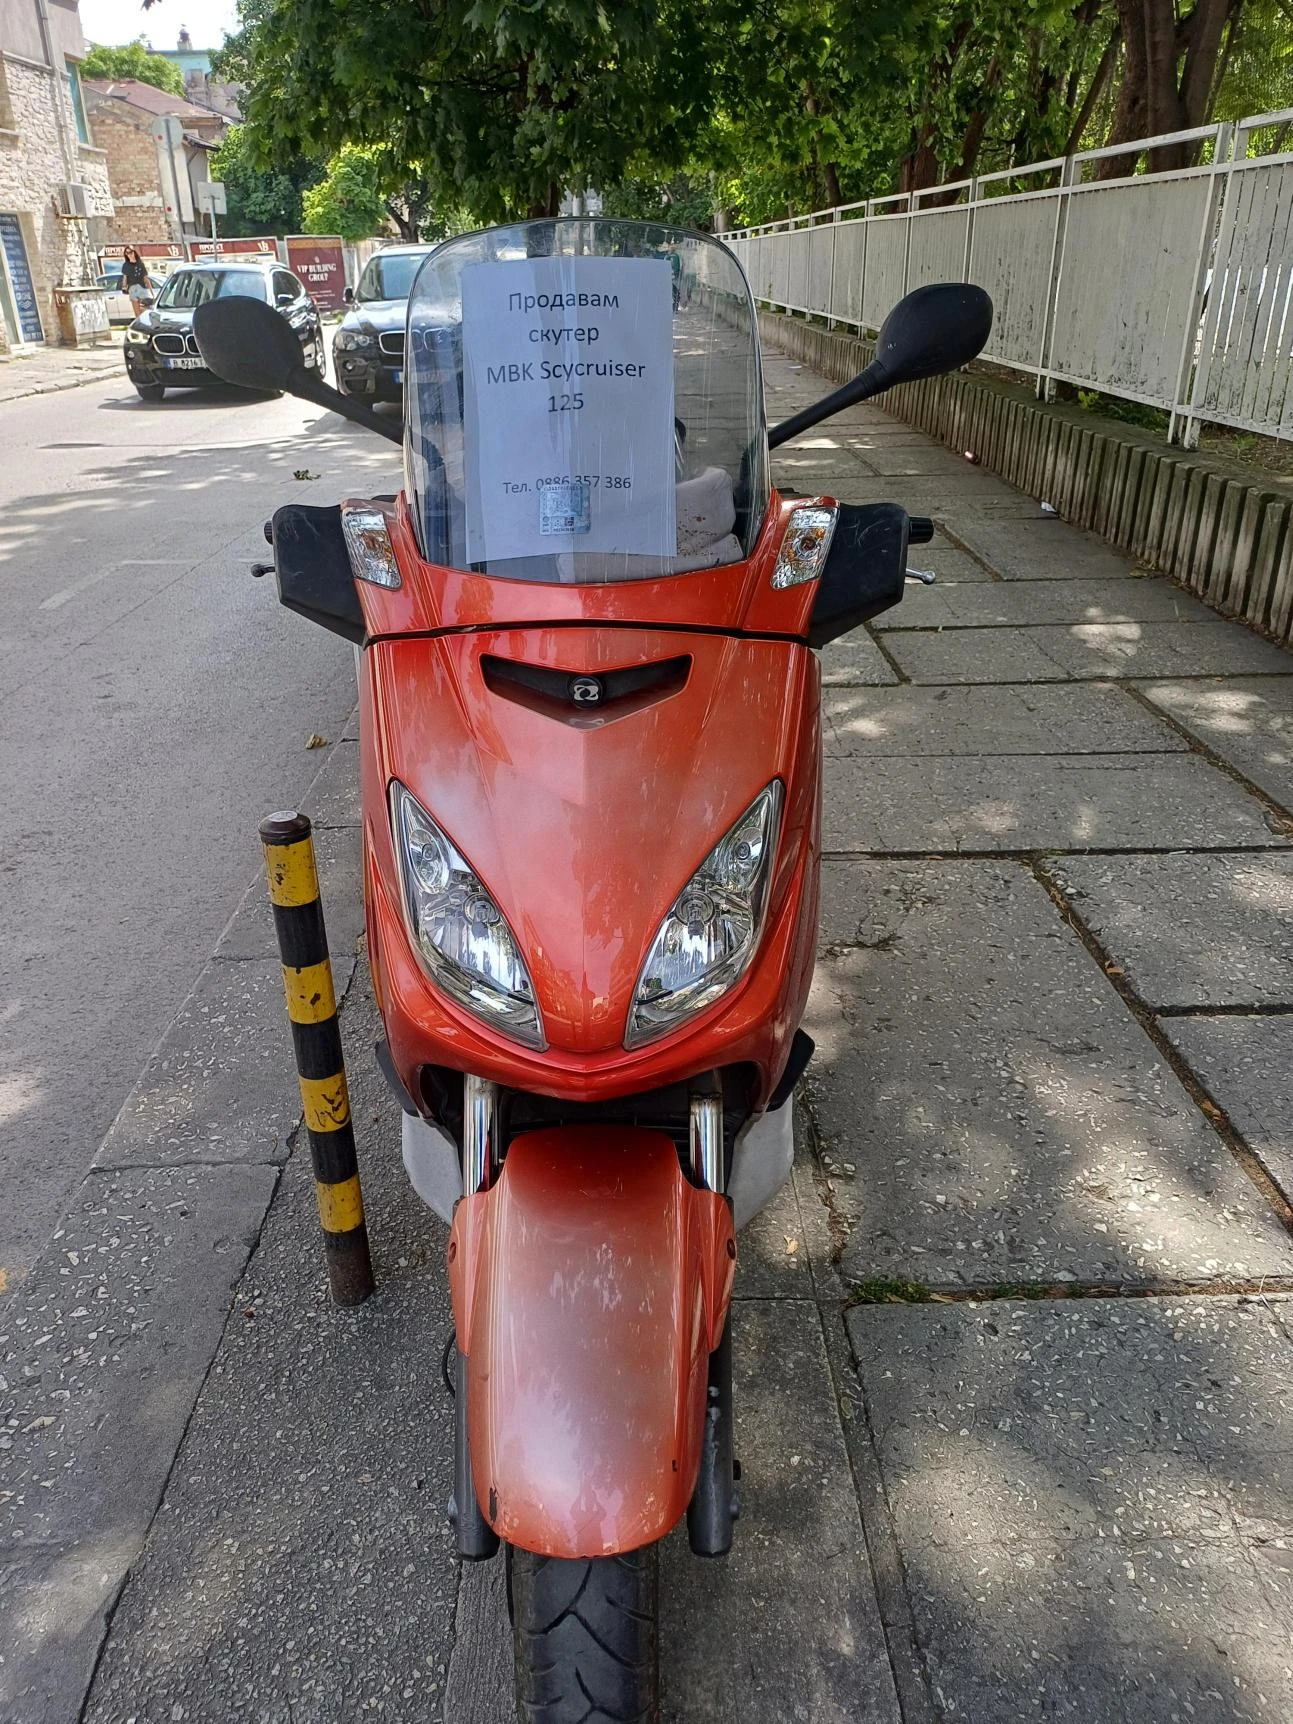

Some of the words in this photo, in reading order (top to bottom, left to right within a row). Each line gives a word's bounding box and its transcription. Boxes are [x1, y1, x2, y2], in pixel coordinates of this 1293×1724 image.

[297, 265, 308, 273] VIP
[308, 263, 337, 273] BUILDING
[308, 273, 328, 282] GROUP
[509, 292, 620, 313] Продавам
[528, 327, 599, 345] скутер
[487, 362, 534, 384] MBK
[540, 360, 646, 382] Scycruiser
[547, 393, 584, 412] 125
[502, 482, 532, 494] Тел.
[604, 476, 632, 489] 386
